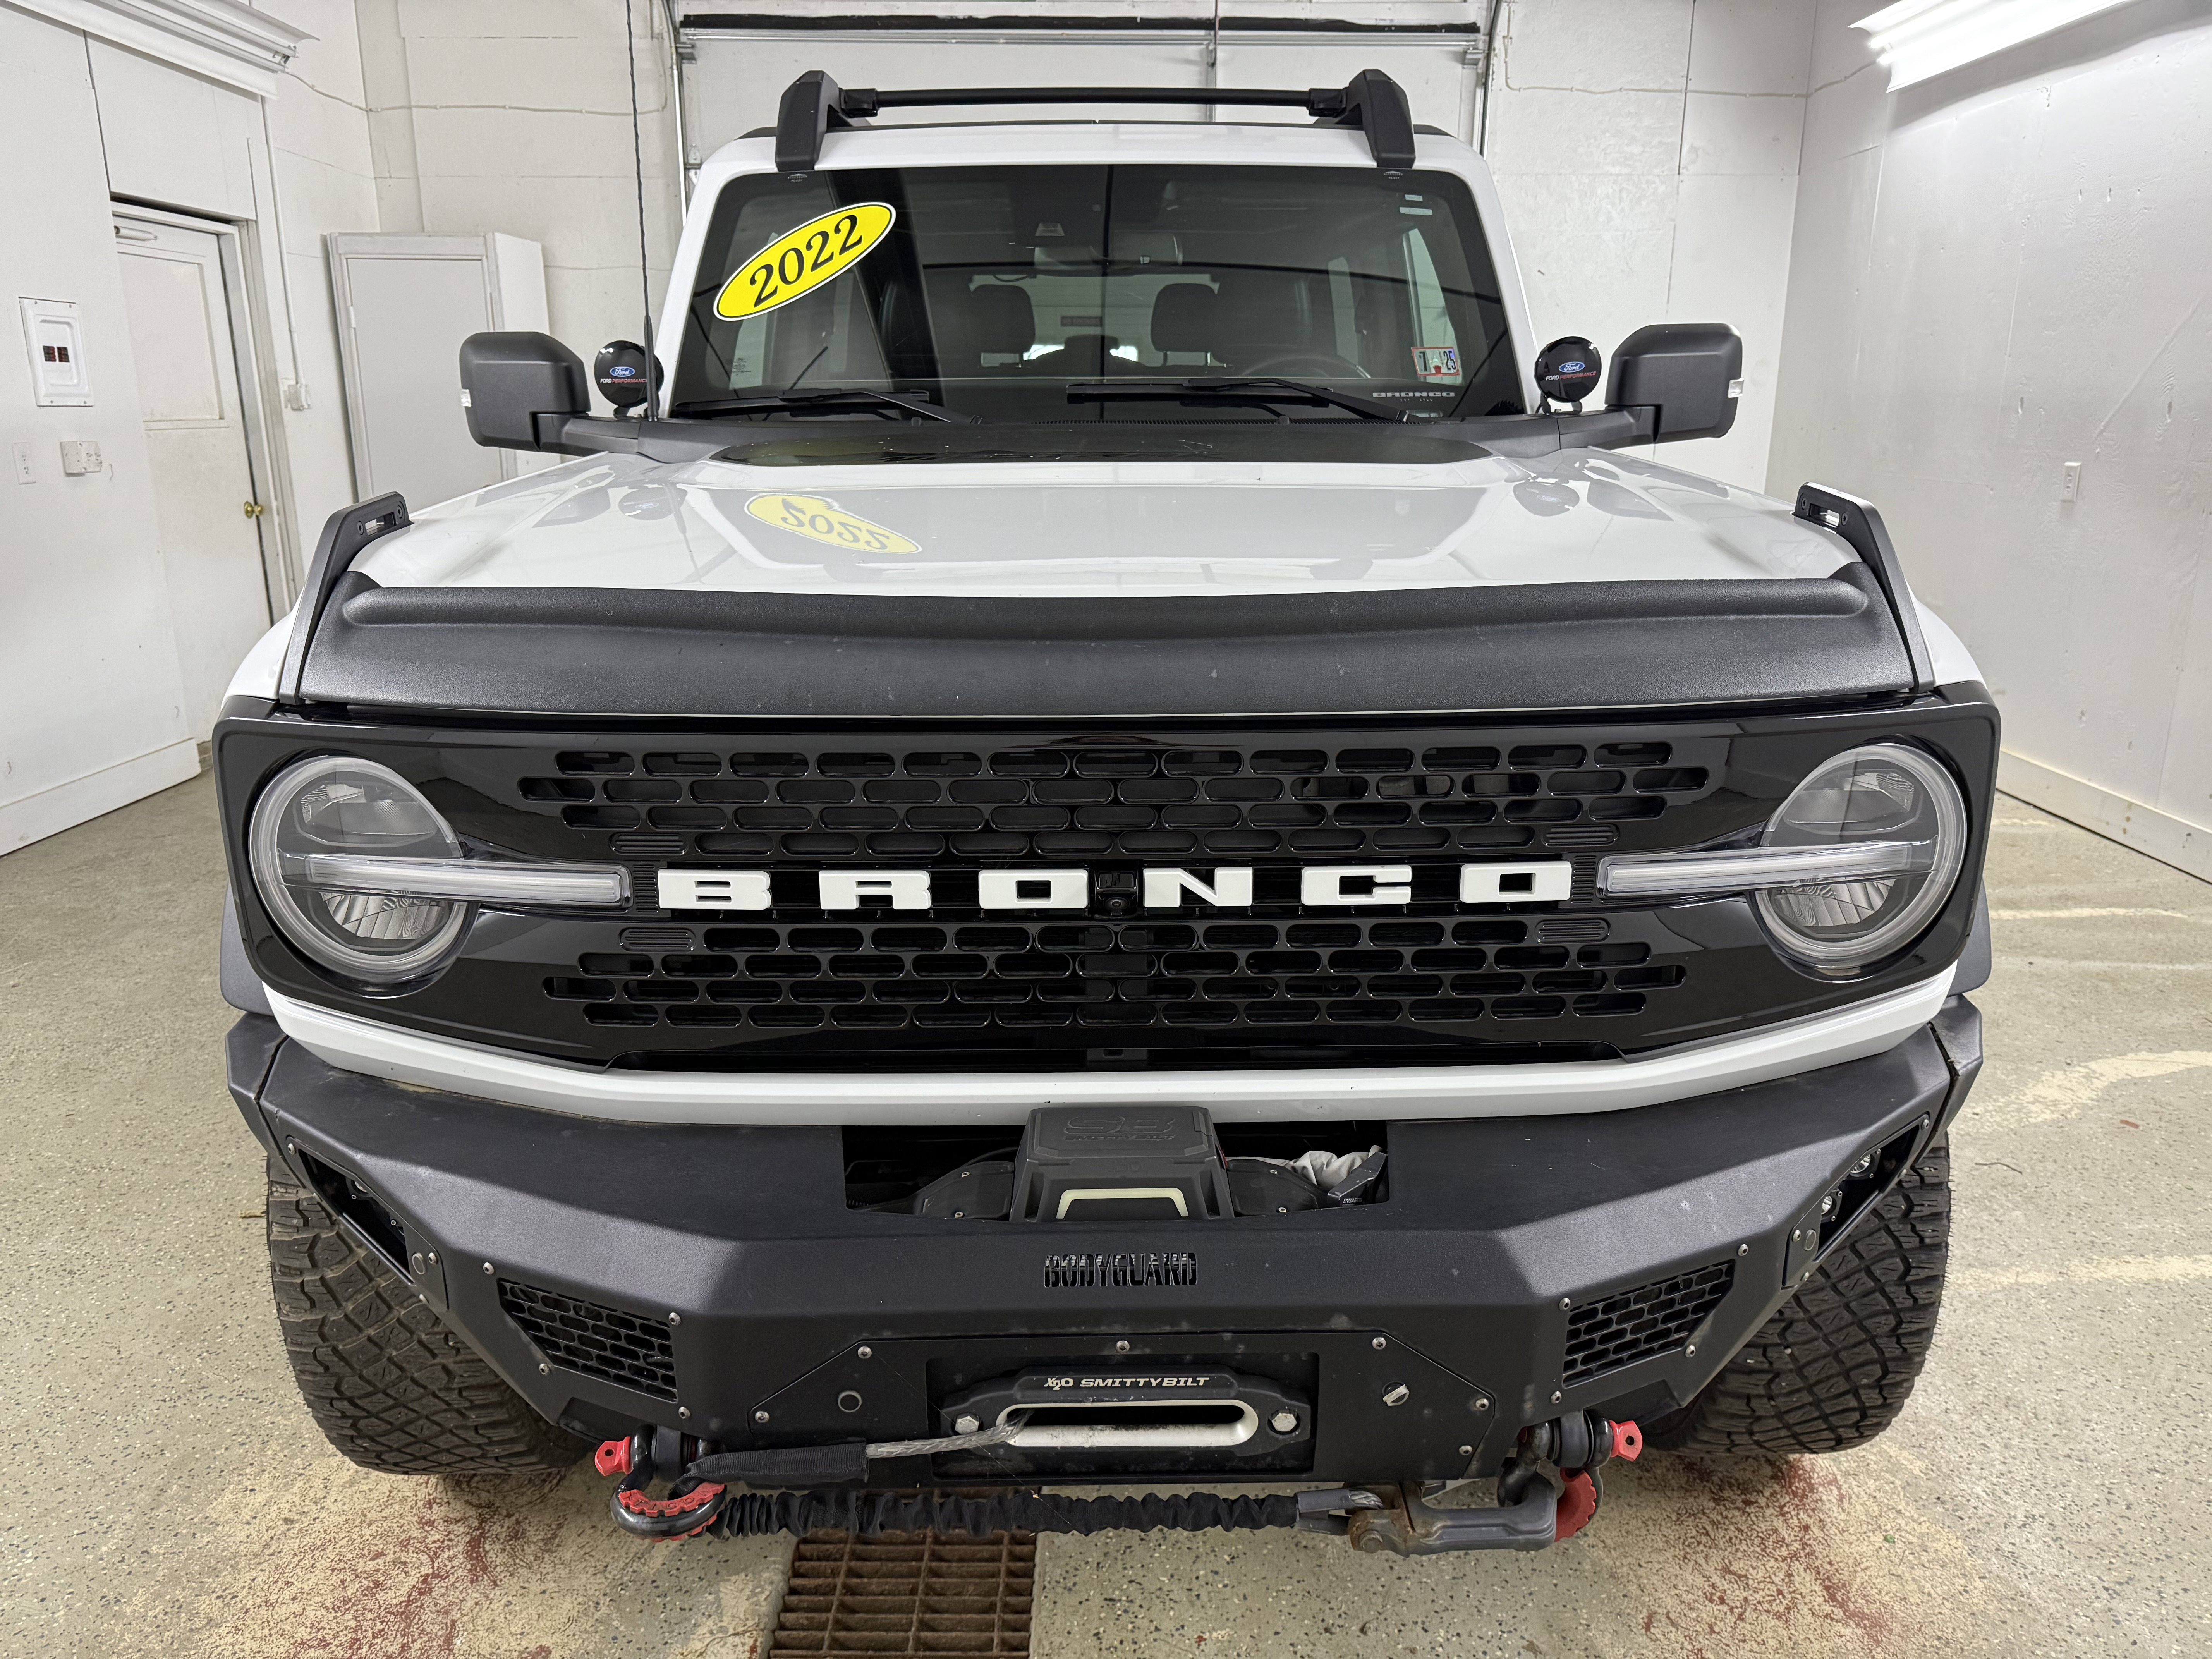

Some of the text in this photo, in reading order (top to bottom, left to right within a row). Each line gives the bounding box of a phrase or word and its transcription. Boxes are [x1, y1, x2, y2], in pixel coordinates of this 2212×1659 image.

[750, 215, 862, 308] 2022
[1443, 350, 1456, 370] 25
[1560, 371, 1596, 379] PERFORMANCE
[658, 860, 1572, 911] BRONCO
[1044, 1252, 1197, 1288] BODYGUARD
[1080, 1377, 1209, 1387] SMITTYBILT
